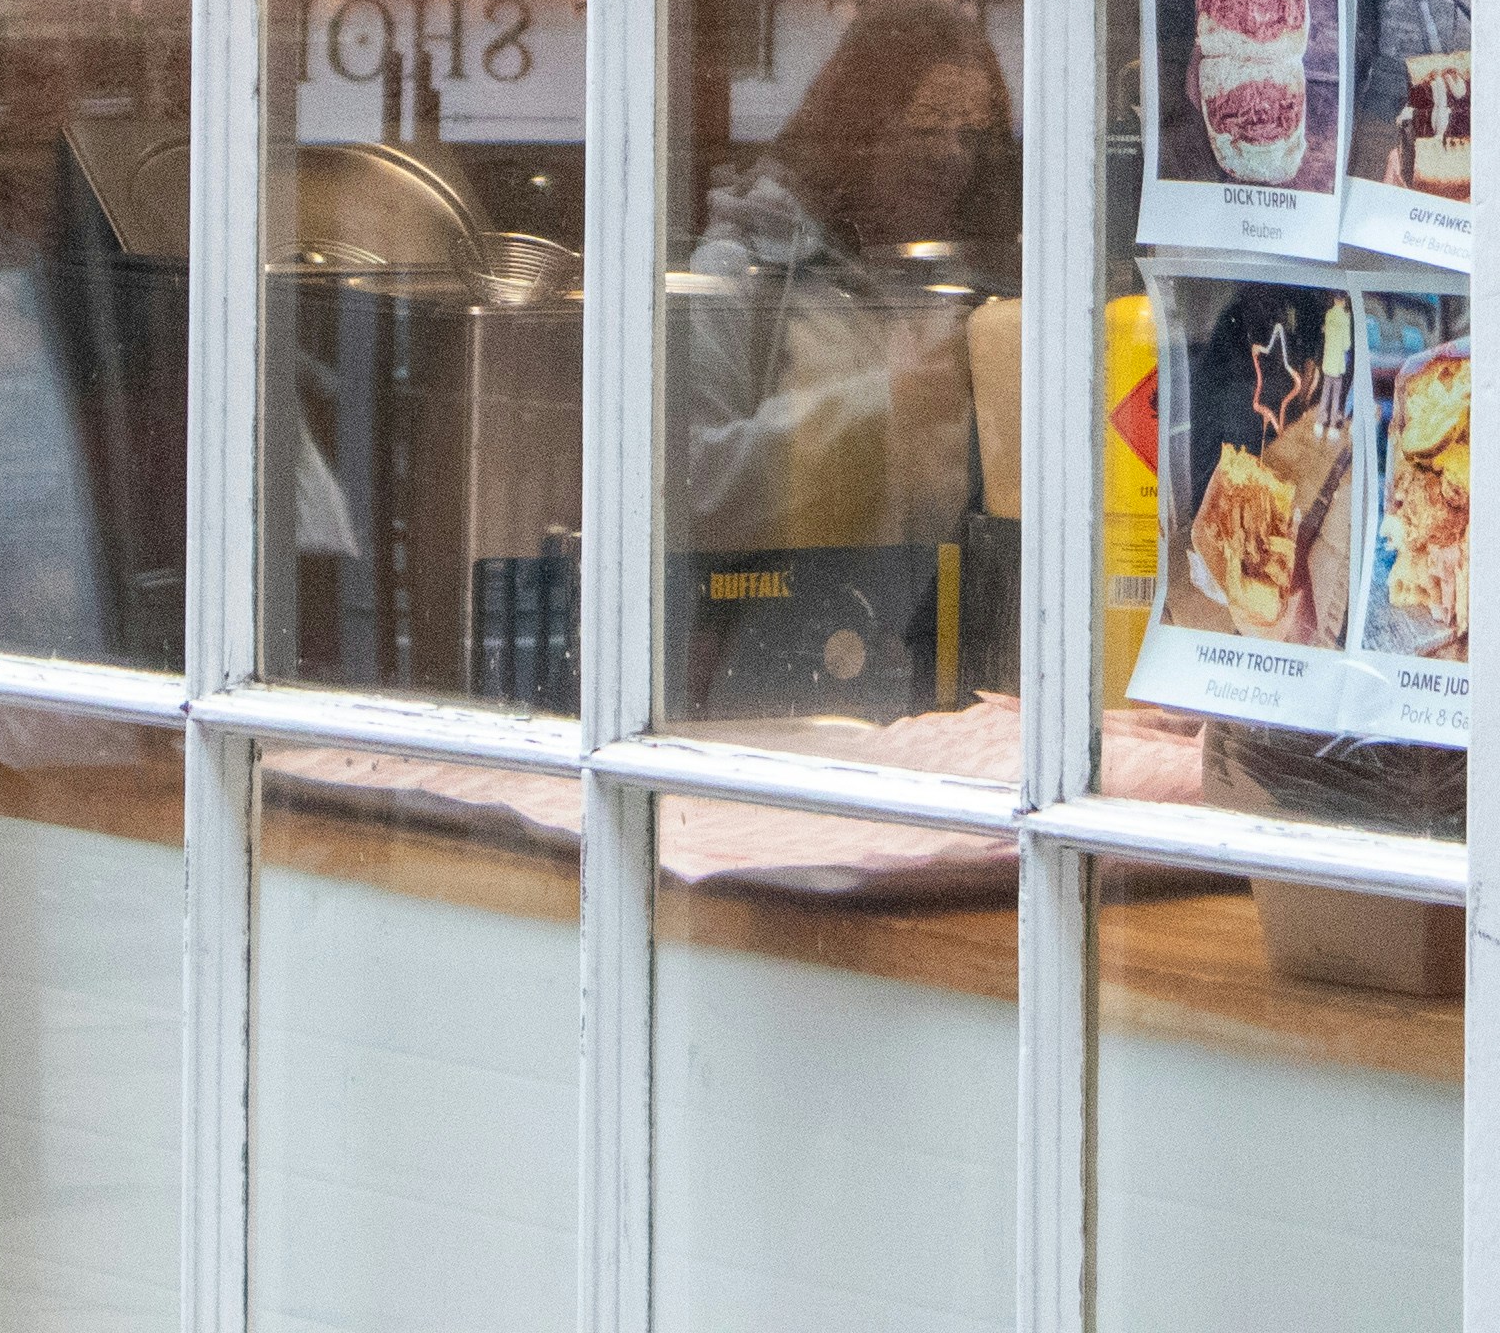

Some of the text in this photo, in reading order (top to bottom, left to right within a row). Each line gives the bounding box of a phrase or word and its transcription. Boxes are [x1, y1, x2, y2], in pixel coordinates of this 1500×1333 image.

[1224, 187, 1297, 210] DICK TURPIN
[1409, 206, 1433, 224] GUY
[1242, 220, 1282, 239] Reuben
[1205, 679, 1281, 707] Pulled Pork
[1401, 703, 1432, 724] Pork
